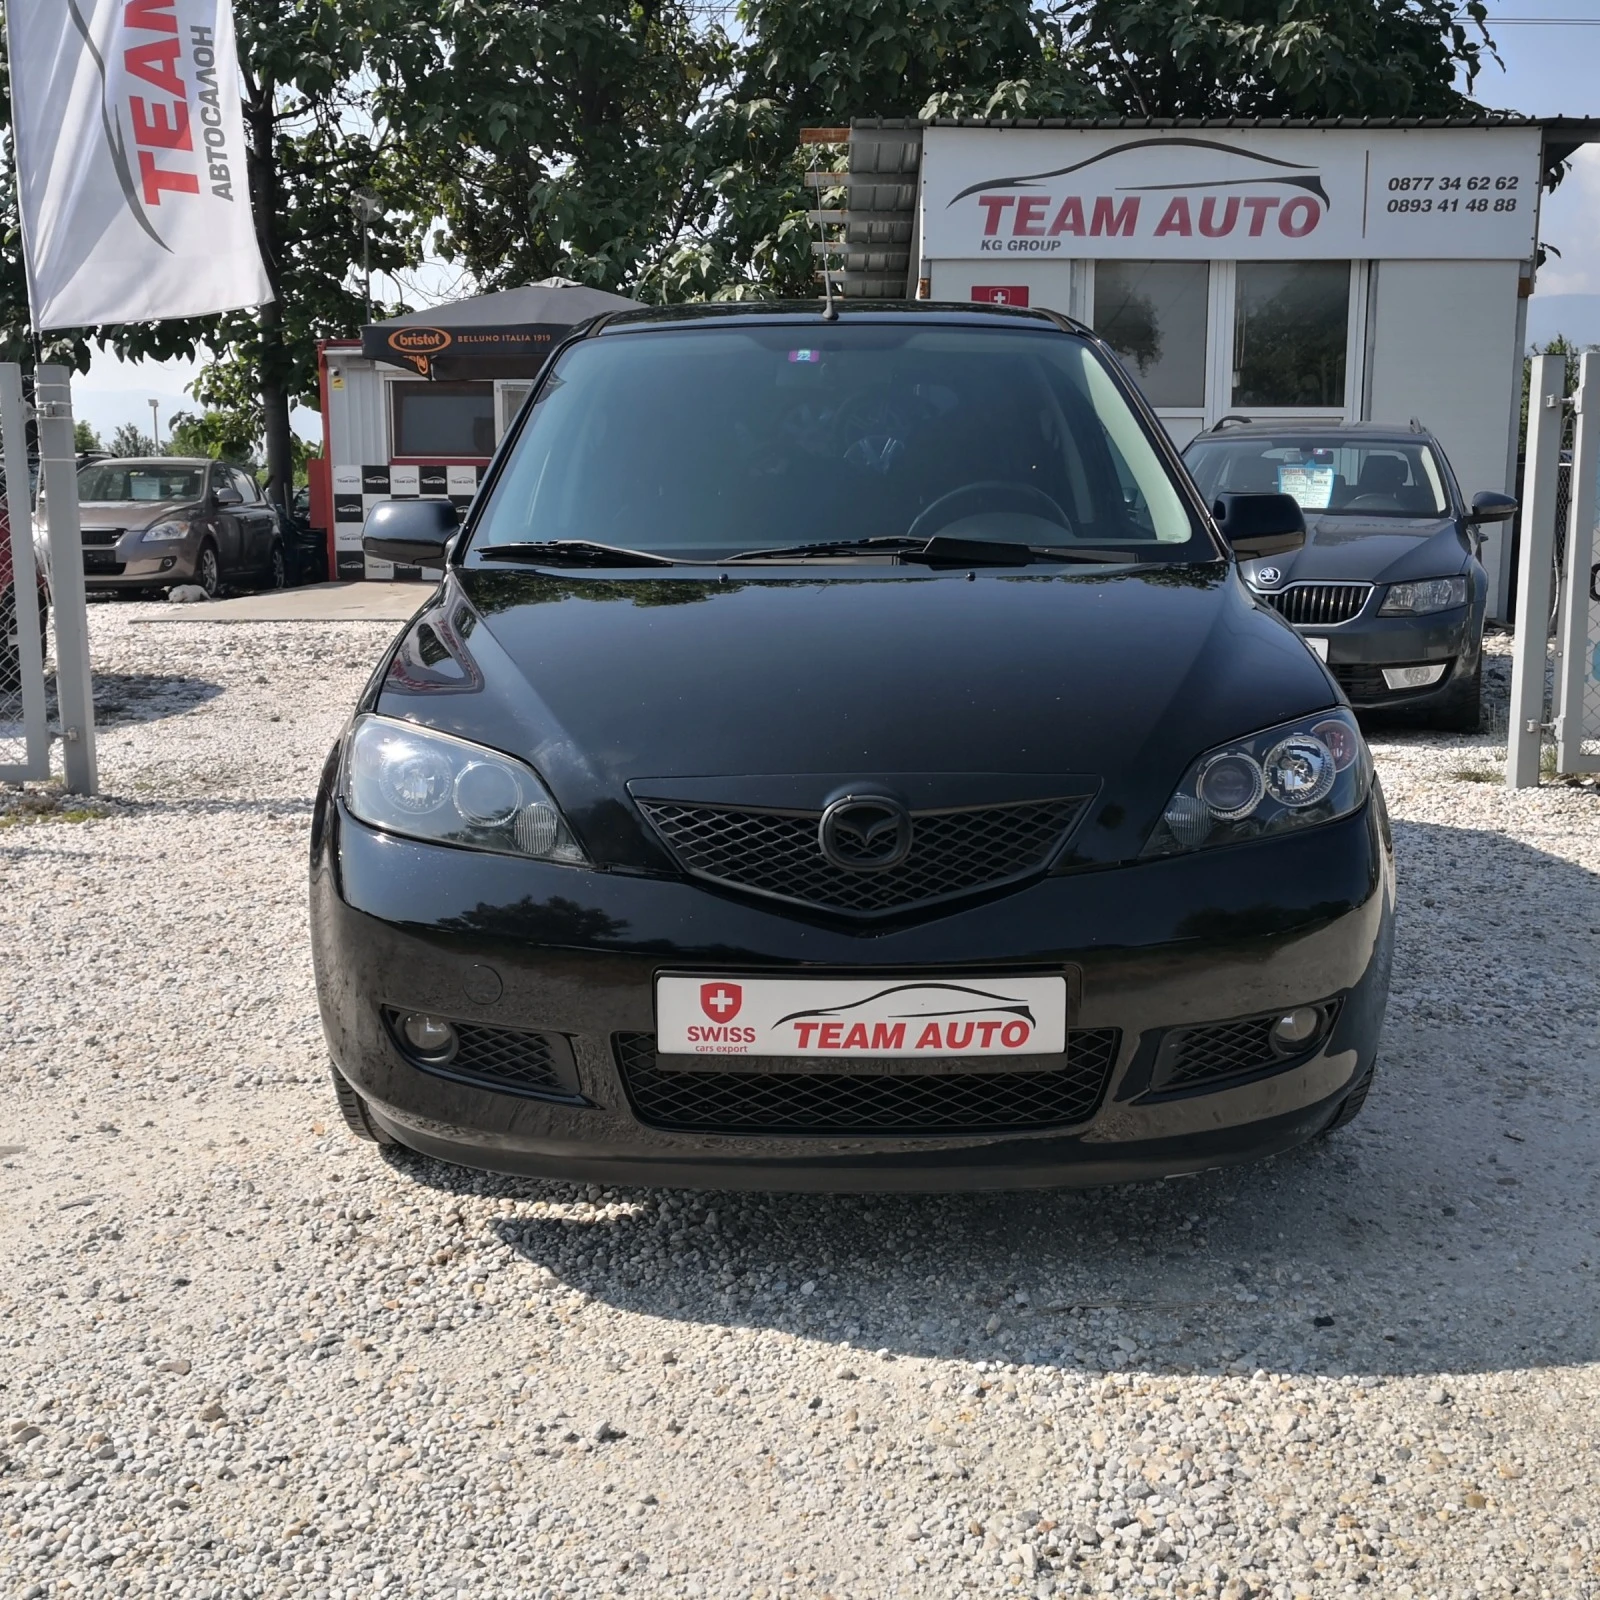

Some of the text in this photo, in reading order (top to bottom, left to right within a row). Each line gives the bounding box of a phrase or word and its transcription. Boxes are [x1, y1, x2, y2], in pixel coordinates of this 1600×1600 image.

[190, 25, 234, 202] АВТОСАЛОН
[1388, 176, 1519, 191] 0877 34 62 62
[1387, 198, 1517, 213] 0893 41 48 88
[978, 195, 1321, 238] TEAM AUTO
[980, 239, 1061, 251] KG GROUP
[399, 333, 441, 346] bristot
[457, 334, 551, 343] BELLUNO ITALIA 1919
[687, 1026, 756, 1043] SWISS
[794, 1020, 1030, 1049] TEAM AUTO
[695, 1044, 749, 1055] cars export
